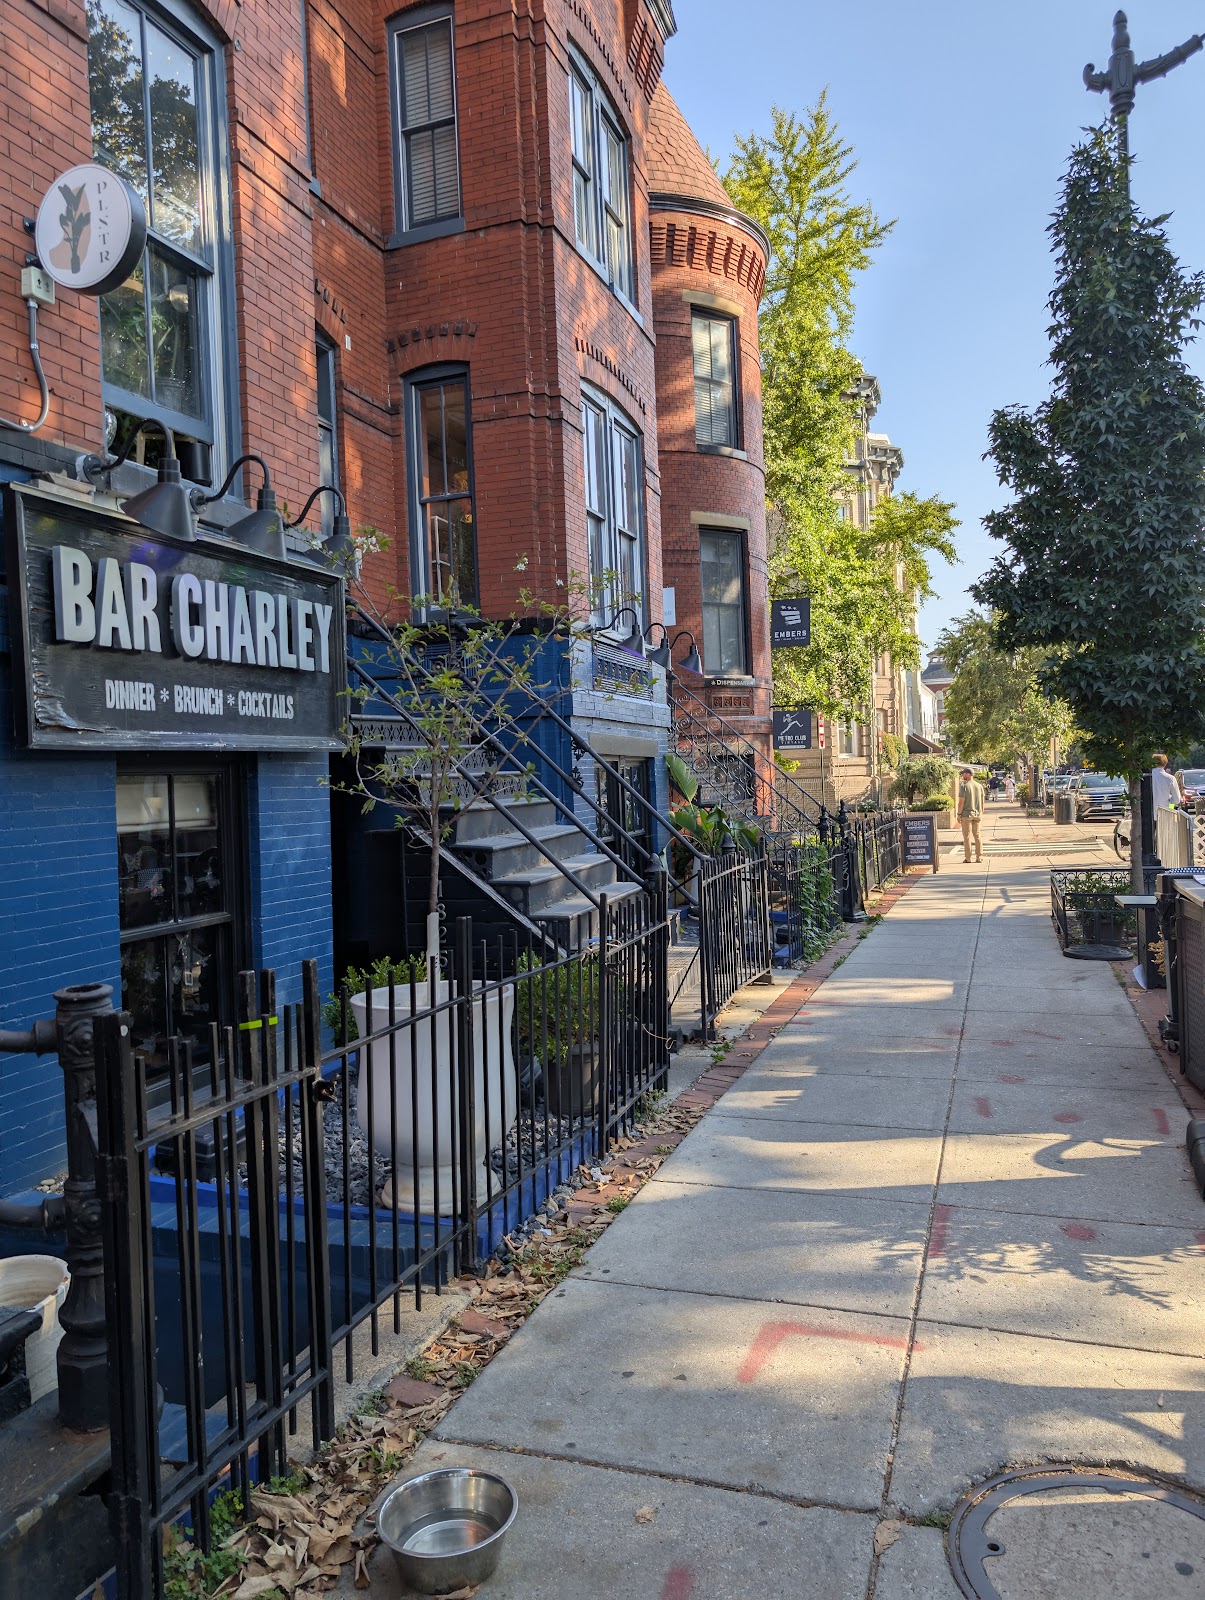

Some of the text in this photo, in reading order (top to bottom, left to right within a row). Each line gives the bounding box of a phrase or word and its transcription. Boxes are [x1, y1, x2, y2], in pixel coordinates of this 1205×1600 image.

[96, 181, 110, 263] PLNTR
[52, 545, 333, 674] BAR CHARLEY
[774, 630, 807, 638] EMBERS
[105, 679, 294, 720] DINNER BRUNCH COCKTAILS
